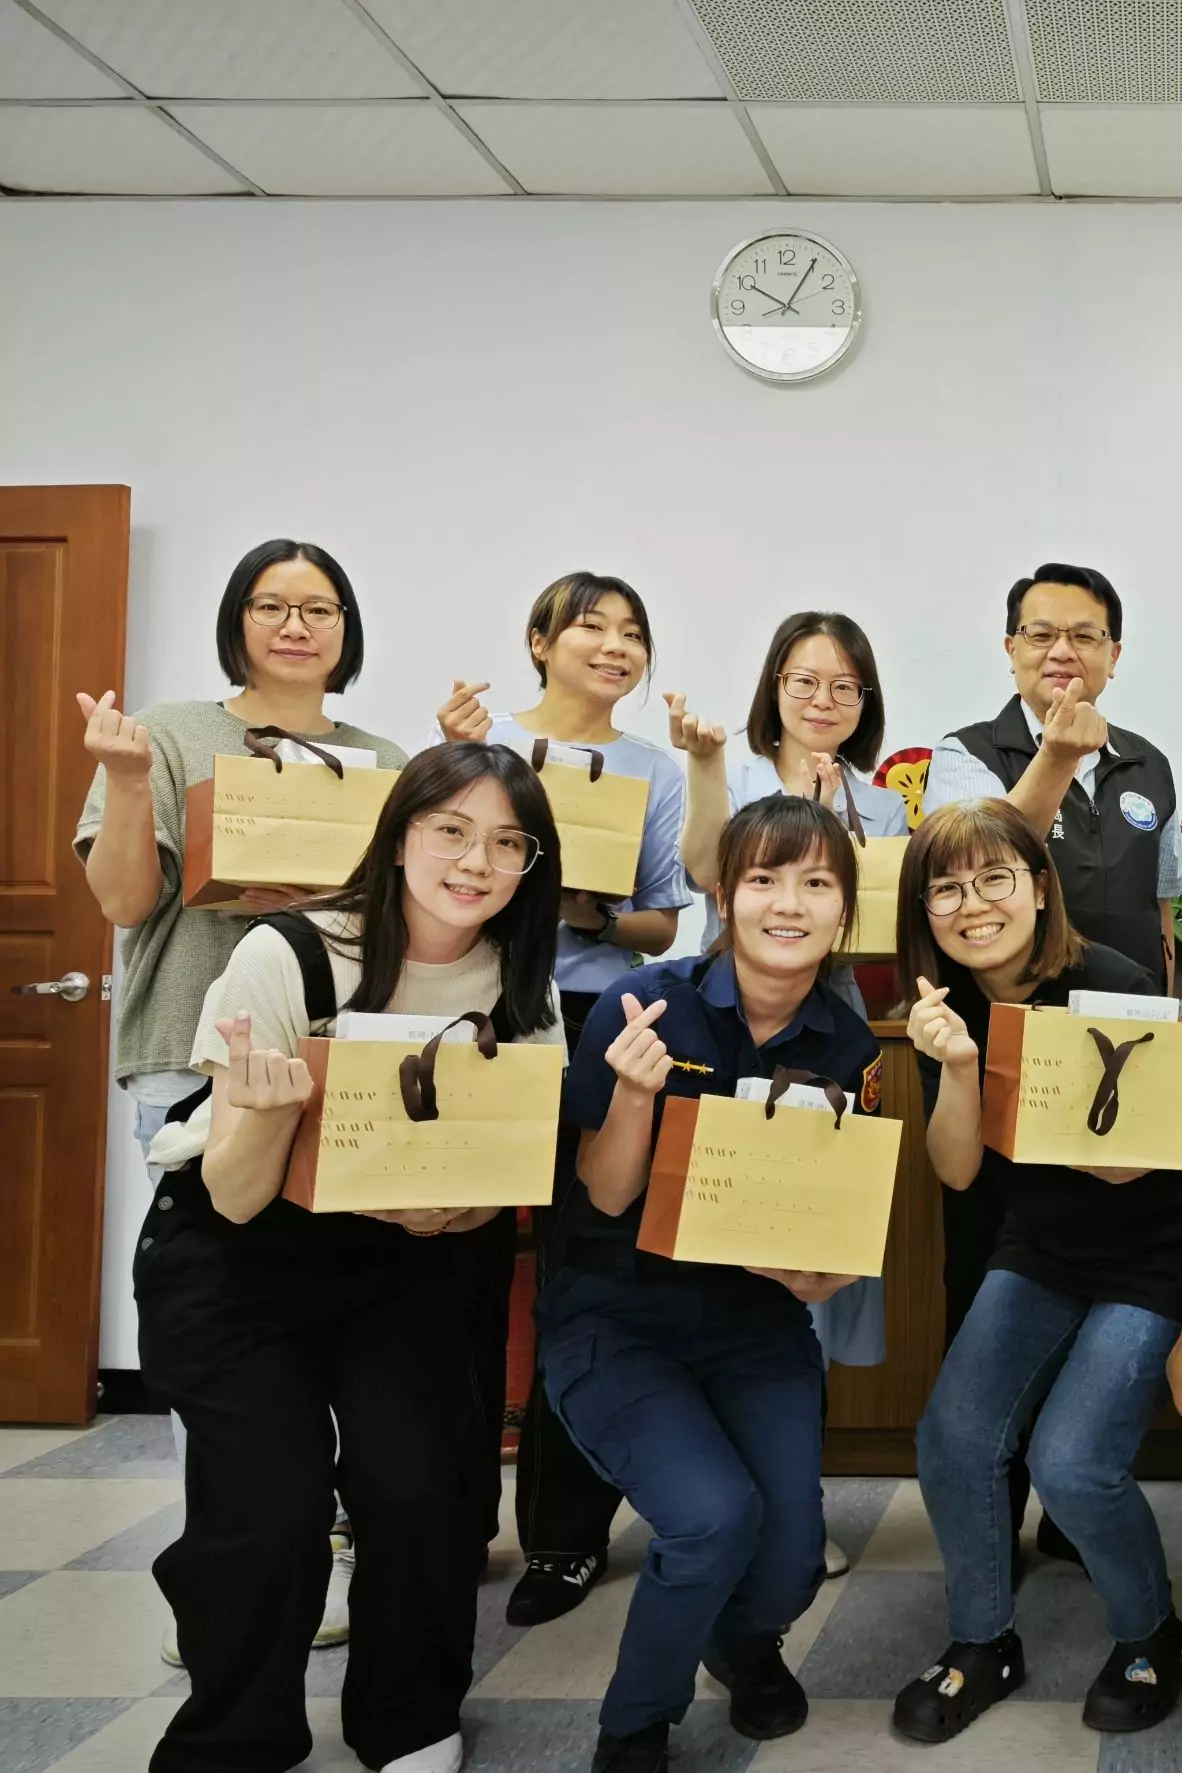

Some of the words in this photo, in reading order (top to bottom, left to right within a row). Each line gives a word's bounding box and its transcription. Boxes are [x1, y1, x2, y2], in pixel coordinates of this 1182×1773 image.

[777, 249, 796, 266] 12
[754, 259, 767, 274] 11
[737, 275, 756, 291] 10
[821, 274, 835, 290] 2
[731, 300, 745, 315] 9
[832, 300, 845, 315] 3
